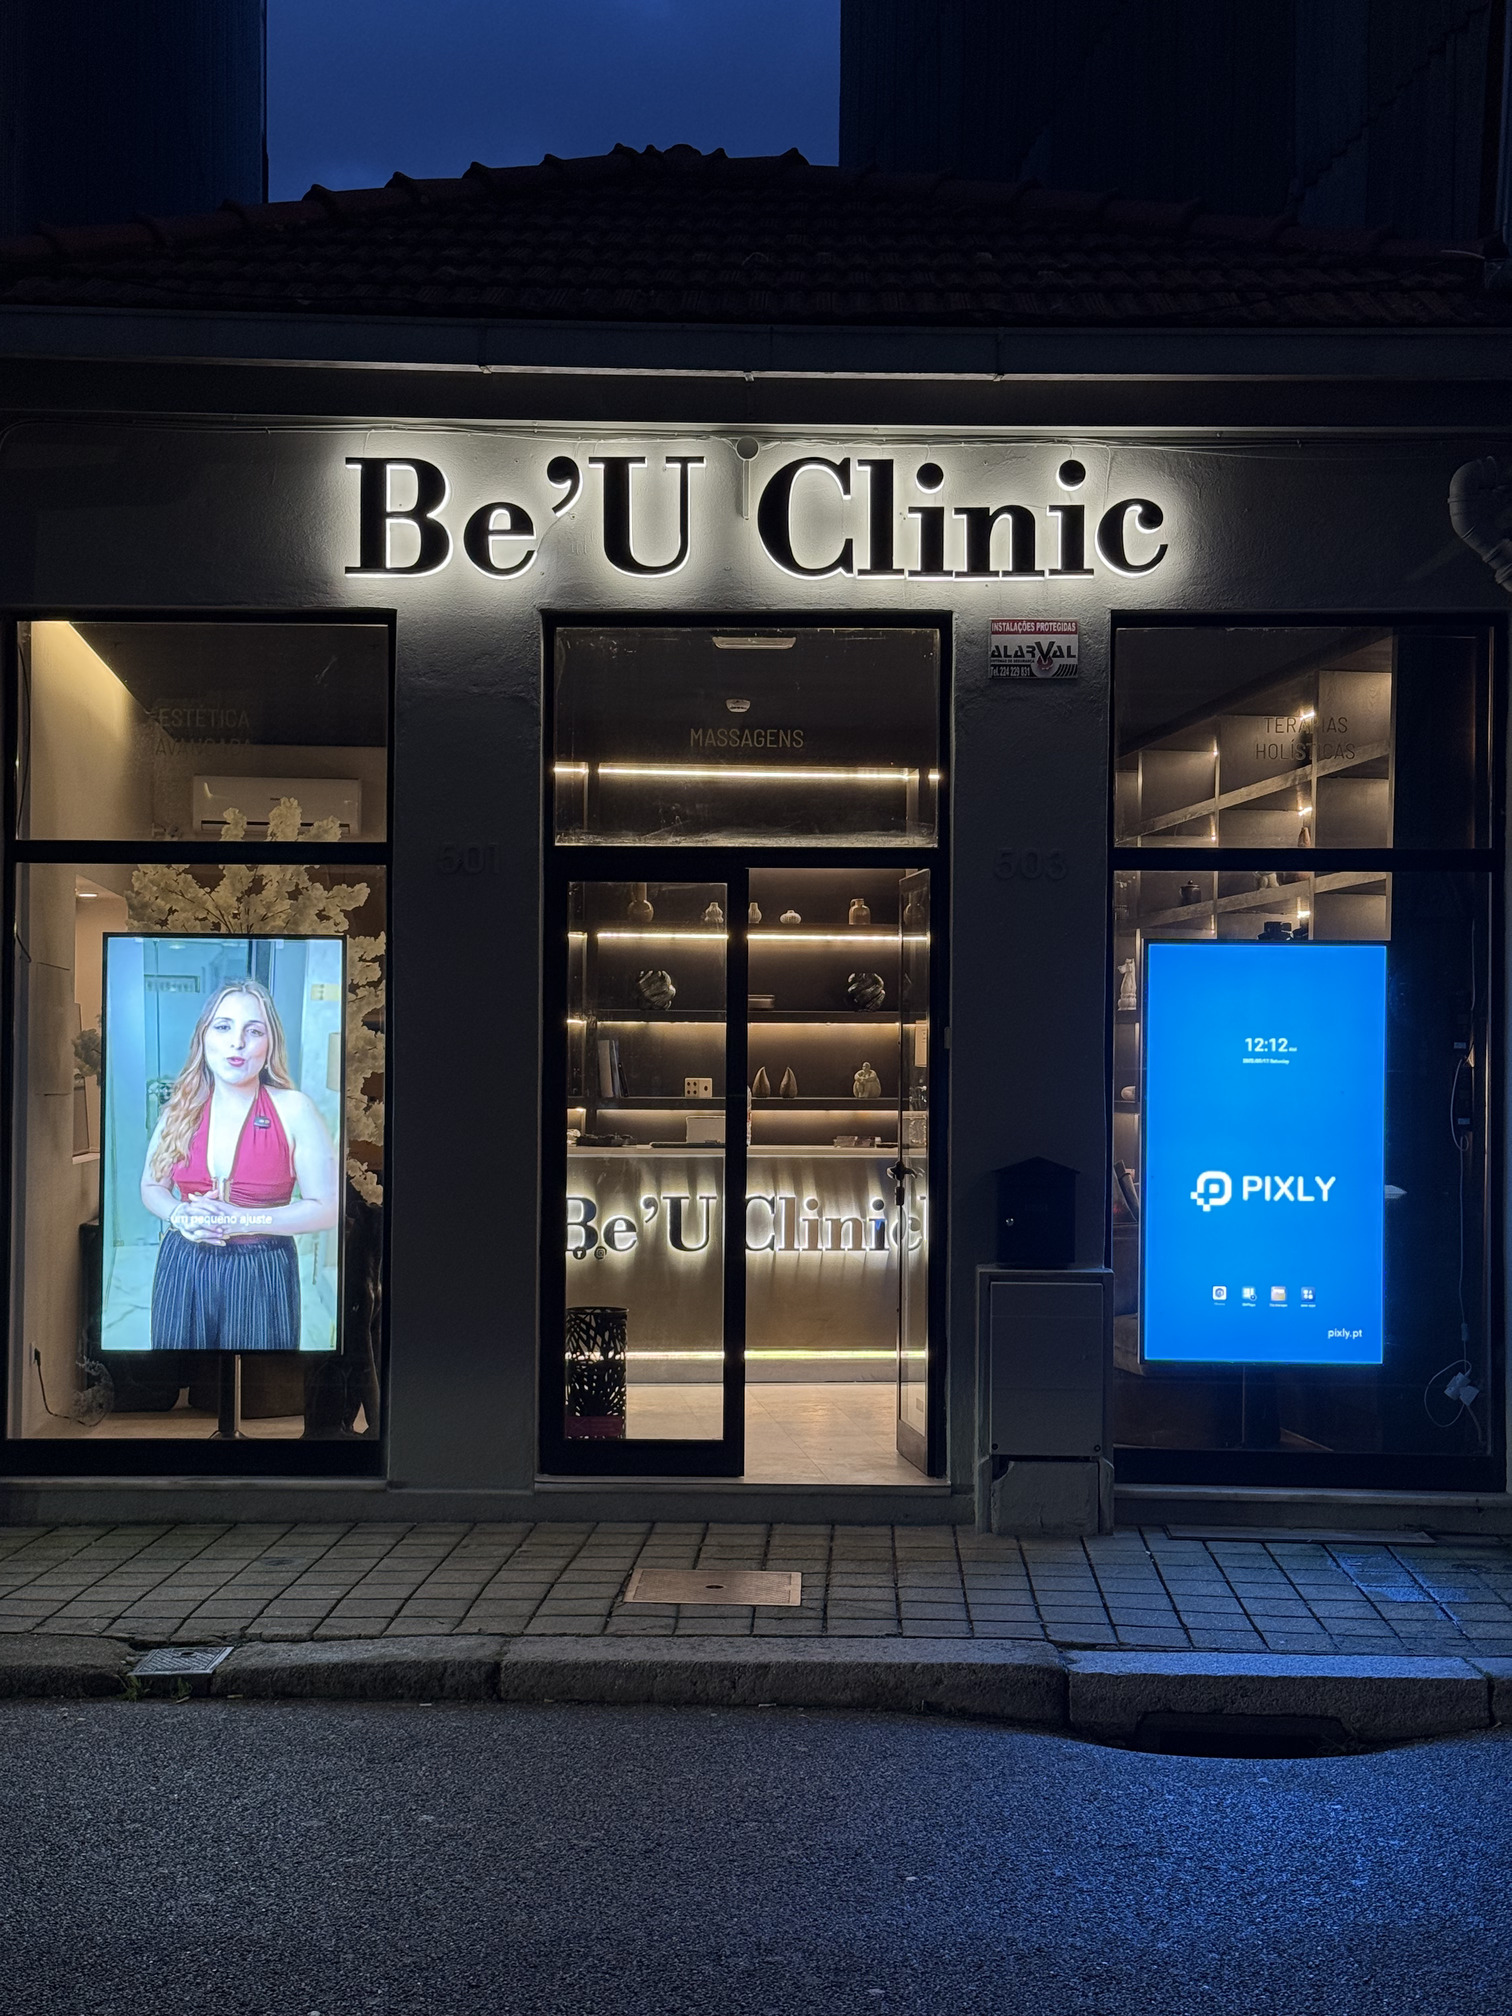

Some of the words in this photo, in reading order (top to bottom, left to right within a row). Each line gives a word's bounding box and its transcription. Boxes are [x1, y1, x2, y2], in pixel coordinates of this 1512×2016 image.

[345, 456, 705, 579] Be’U
[757, 456, 1169, 582] Clinic
[992, 620, 1035, 633] INSTALAÇÕES
[1036, 622, 1076, 632] PROTEGIDAS
[158, 705, 250, 729] ESTÉTICA
[690, 728, 804, 748] MASSAGENS
[432, 842, 500, 876] 501
[993, 847, 1069, 882] 503
[1245, 1037, 1288, 1052] 12:12
[1242, 1175, 1336, 1202] PIXLY
[171, 1215, 189, 1224] um
[190, 1215, 237, 1226] pequeno
[239, 1214, 273, 1226] ajuste
[1327, 1328, 1363, 1340] pixly.pt
